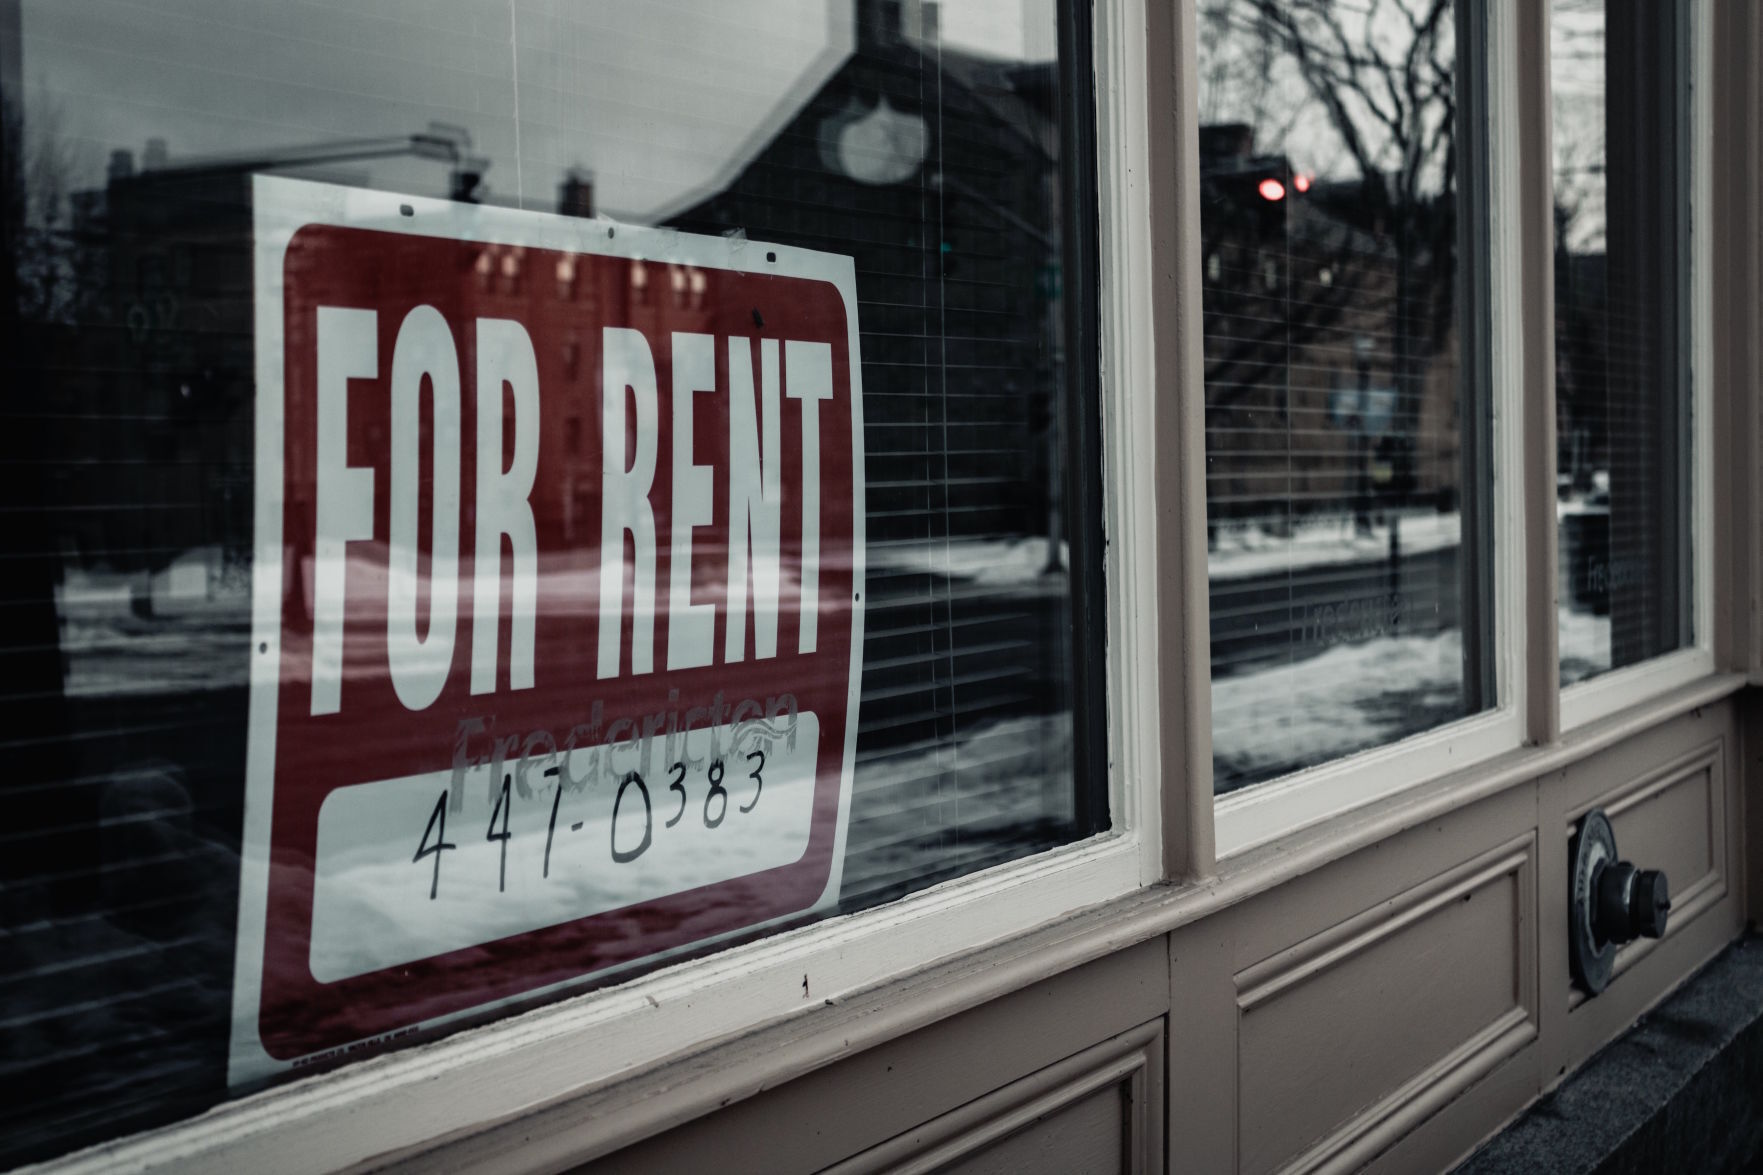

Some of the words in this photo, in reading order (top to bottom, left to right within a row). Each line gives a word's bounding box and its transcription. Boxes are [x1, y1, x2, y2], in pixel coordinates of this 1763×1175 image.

[310, 304, 540, 717] FOR
[597, 326, 834, 680] RENT
[412, 750, 766, 900] 447-0383
[448, 689, 799, 815] Fredericton
